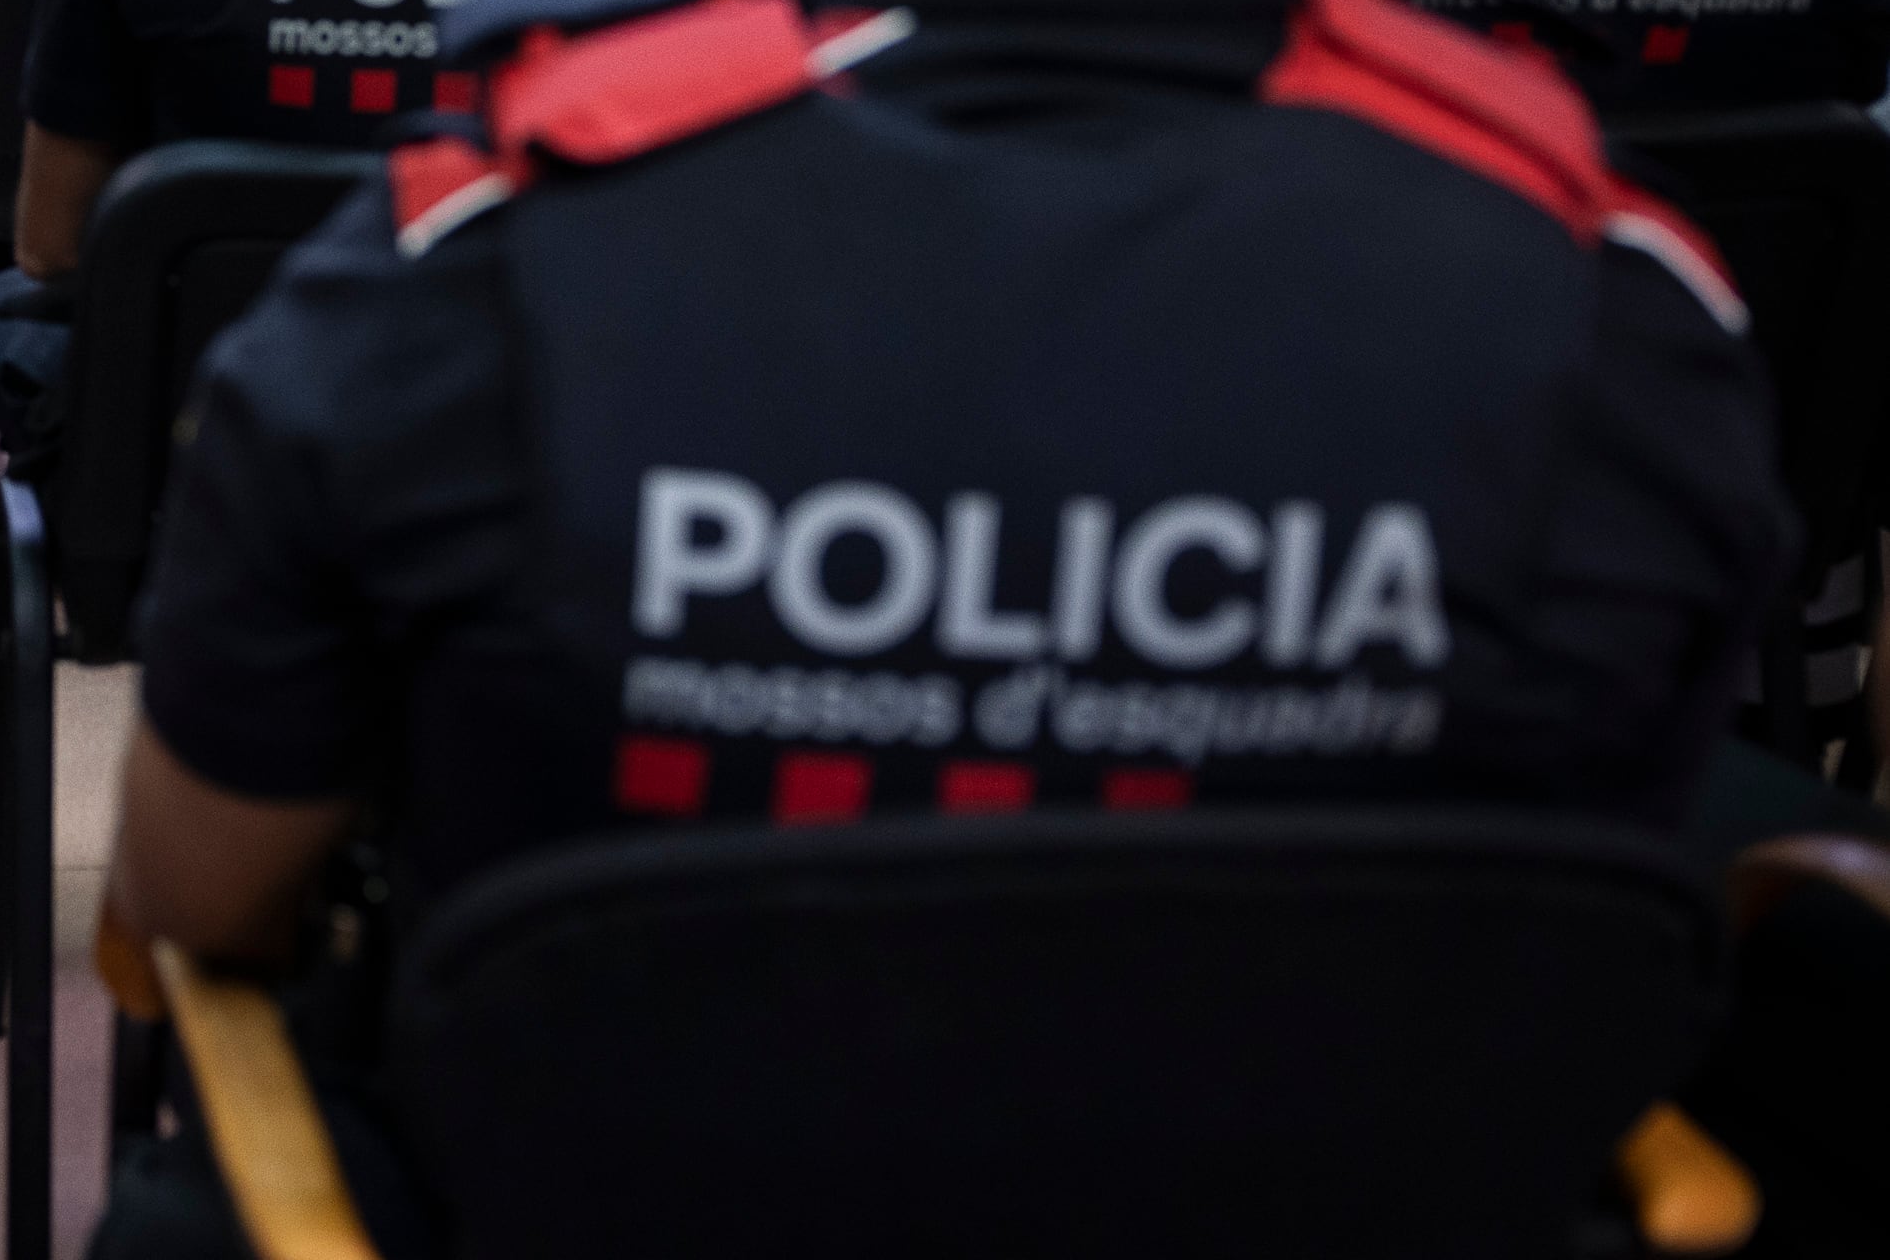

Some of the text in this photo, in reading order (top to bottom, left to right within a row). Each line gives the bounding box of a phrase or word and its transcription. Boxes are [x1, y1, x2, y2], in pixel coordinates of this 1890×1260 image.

[267, 17, 440, 59] mossos
[630, 462, 1452, 673] POLICIA
[621, 655, 965, 747] mossos
